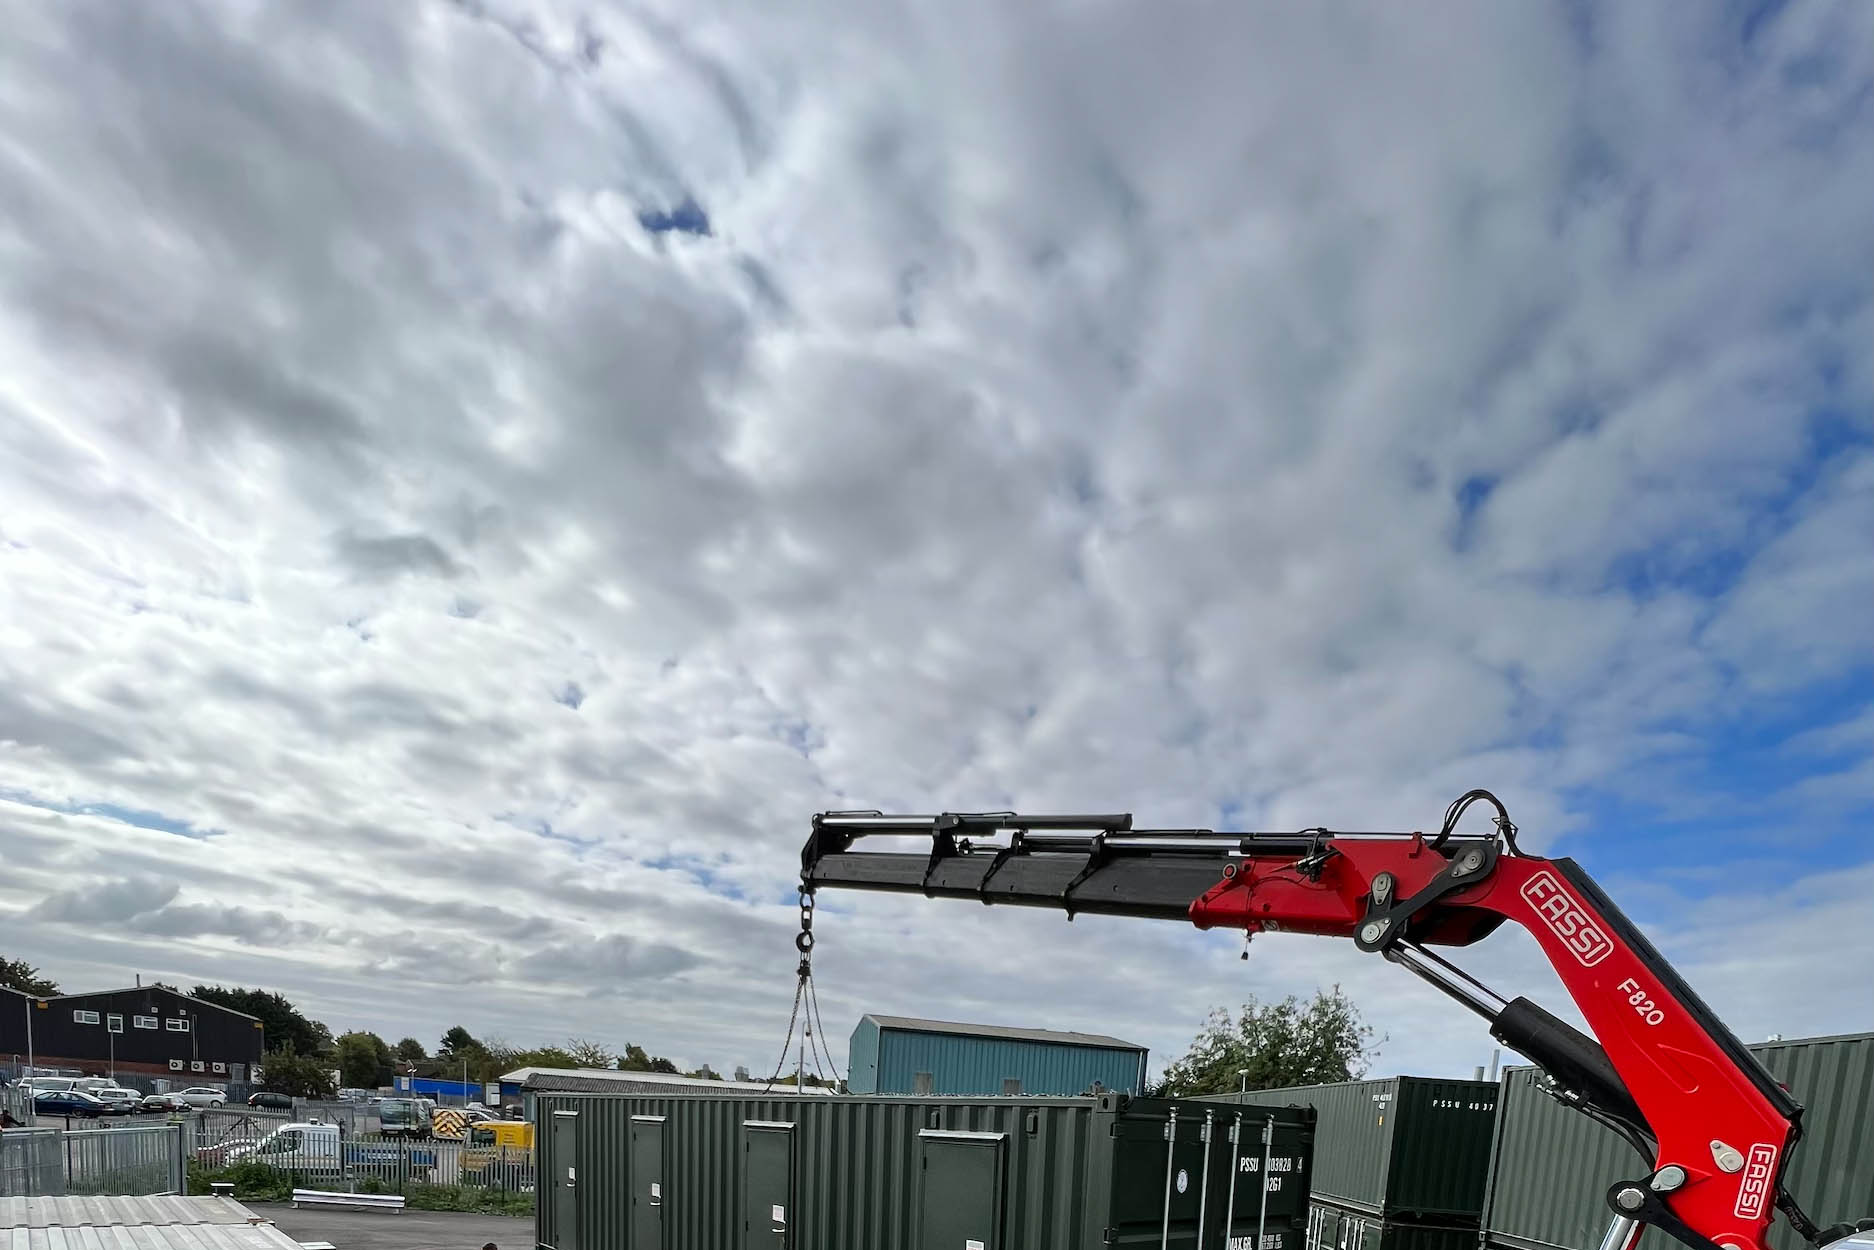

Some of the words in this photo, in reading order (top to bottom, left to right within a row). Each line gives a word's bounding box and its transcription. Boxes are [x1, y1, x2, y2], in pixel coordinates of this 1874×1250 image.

[1527, 878, 1606, 960] FASSI
[1616, 977, 1665, 1027] F820
[1240, 1157, 1259, 1172] PSSU
[1739, 1150, 1771, 1214] FASSI
